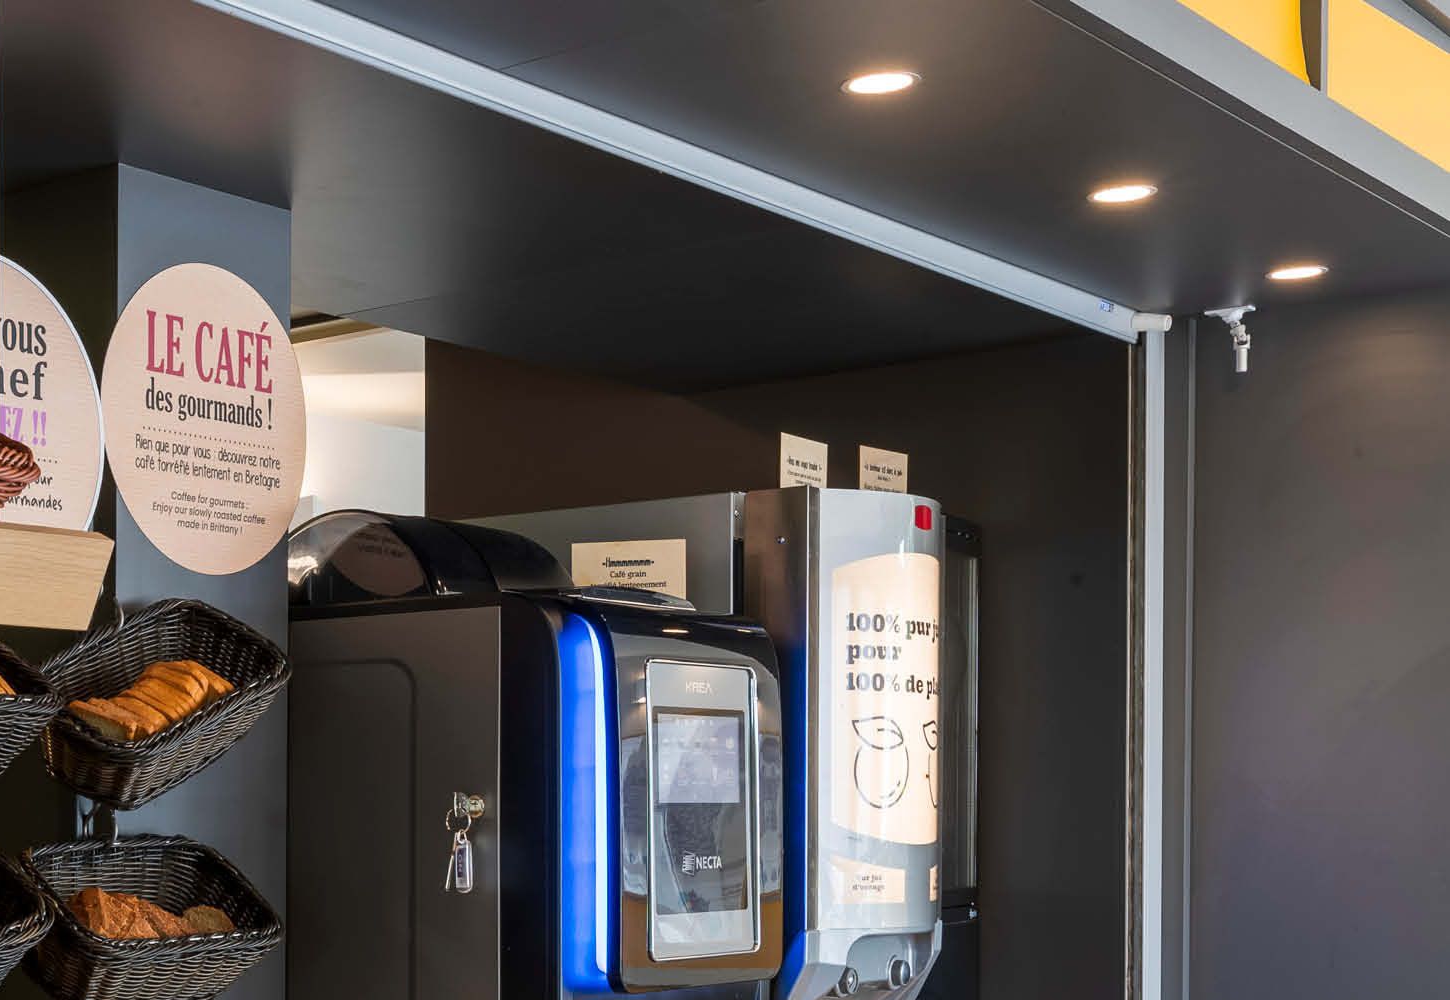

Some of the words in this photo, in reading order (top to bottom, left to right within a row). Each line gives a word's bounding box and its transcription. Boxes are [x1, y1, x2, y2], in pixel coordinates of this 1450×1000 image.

[145, 309, 185, 378] LE
[194, 320, 273, 395] CAFÉ
[145, 376, 173, 413] des
[177, 394, 263, 429] gourmands
[267, 398, 273, 430] !
[135, 433, 153, 450] Rien
[155, 439, 170, 458] que
[171, 442, 192, 457] pour
[193, 447, 212, 460] vous
[217, 447, 258, 467] découvrez
[259, 455, 281, 470] notre
[134, 454, 155, 470] café
[157, 457, 191, 475] torréfié
[192, 462, 231, 482] lentement
[233, 472, 244, 484] en
[245, 469, 281, 491] Bretagne
[5, 493, 63, 511] urmandes
[170, 490, 196, 503] Coffee
[198, 493, 209, 504] for
[152, 501, 173, 514] Enjoy
[174, 506, 188, 515] our
[189, 505, 213, 519] slowly
[213, 509, 242, 521] roasted
[243, 513, 266, 525] coffee
[177, 518, 200, 529] made
[201, 520, 209, 530] in
[209, 522, 239, 536] Brittany
[609, 570, 626, 579] Café
[627, 569, 647, 579] grain
[846, 612, 901, 633] 100%
[905, 620, 931, 640] pur
[846, 644, 902, 665] pour
[846, 672, 901, 692] 100%
[906, 675, 924, 694] de
[696, 856, 723, 870] NECTA
